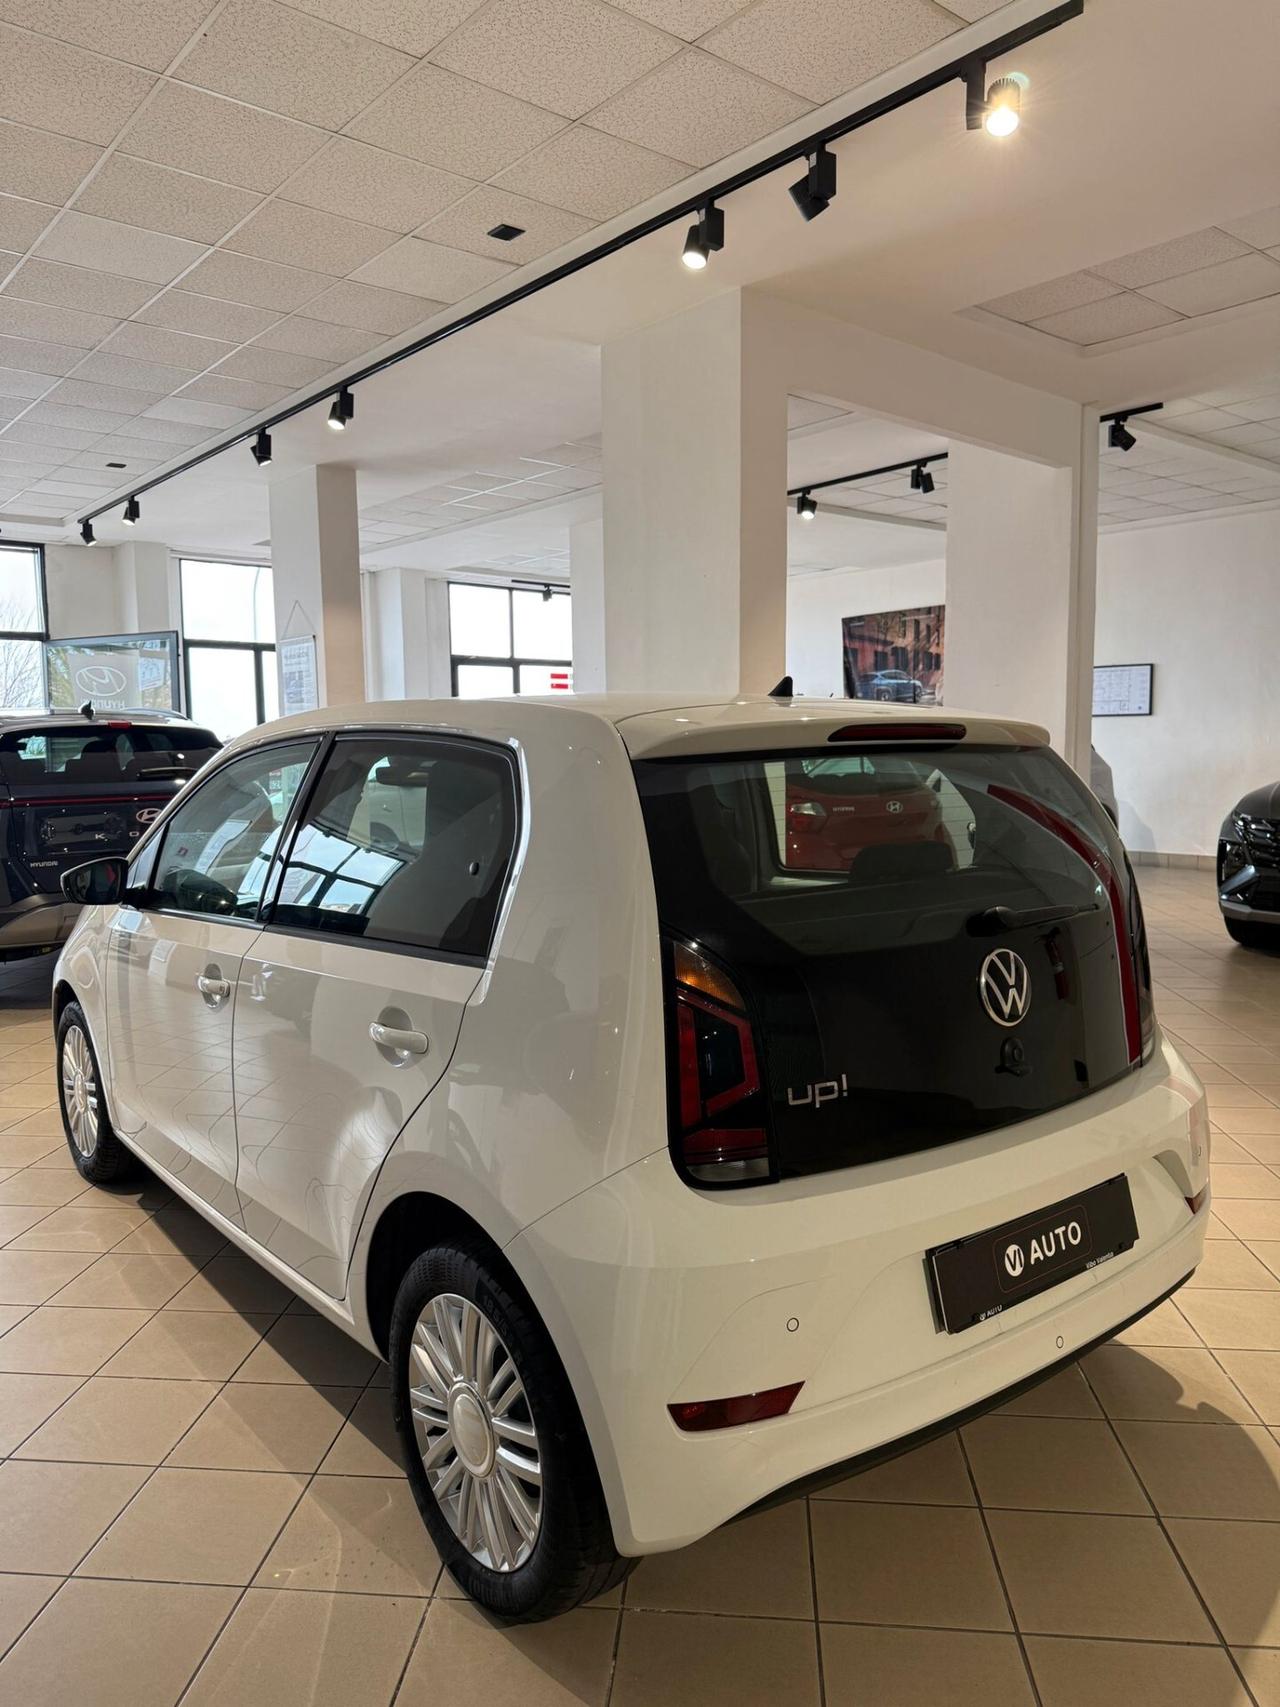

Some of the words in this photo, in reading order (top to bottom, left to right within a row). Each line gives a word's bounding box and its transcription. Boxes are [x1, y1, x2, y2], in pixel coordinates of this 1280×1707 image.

[30, 860, 59, 868] HYUNDAI
[787, 1073, 848, 1108] up!
[1029, 1221, 1082, 1265] AUTO
